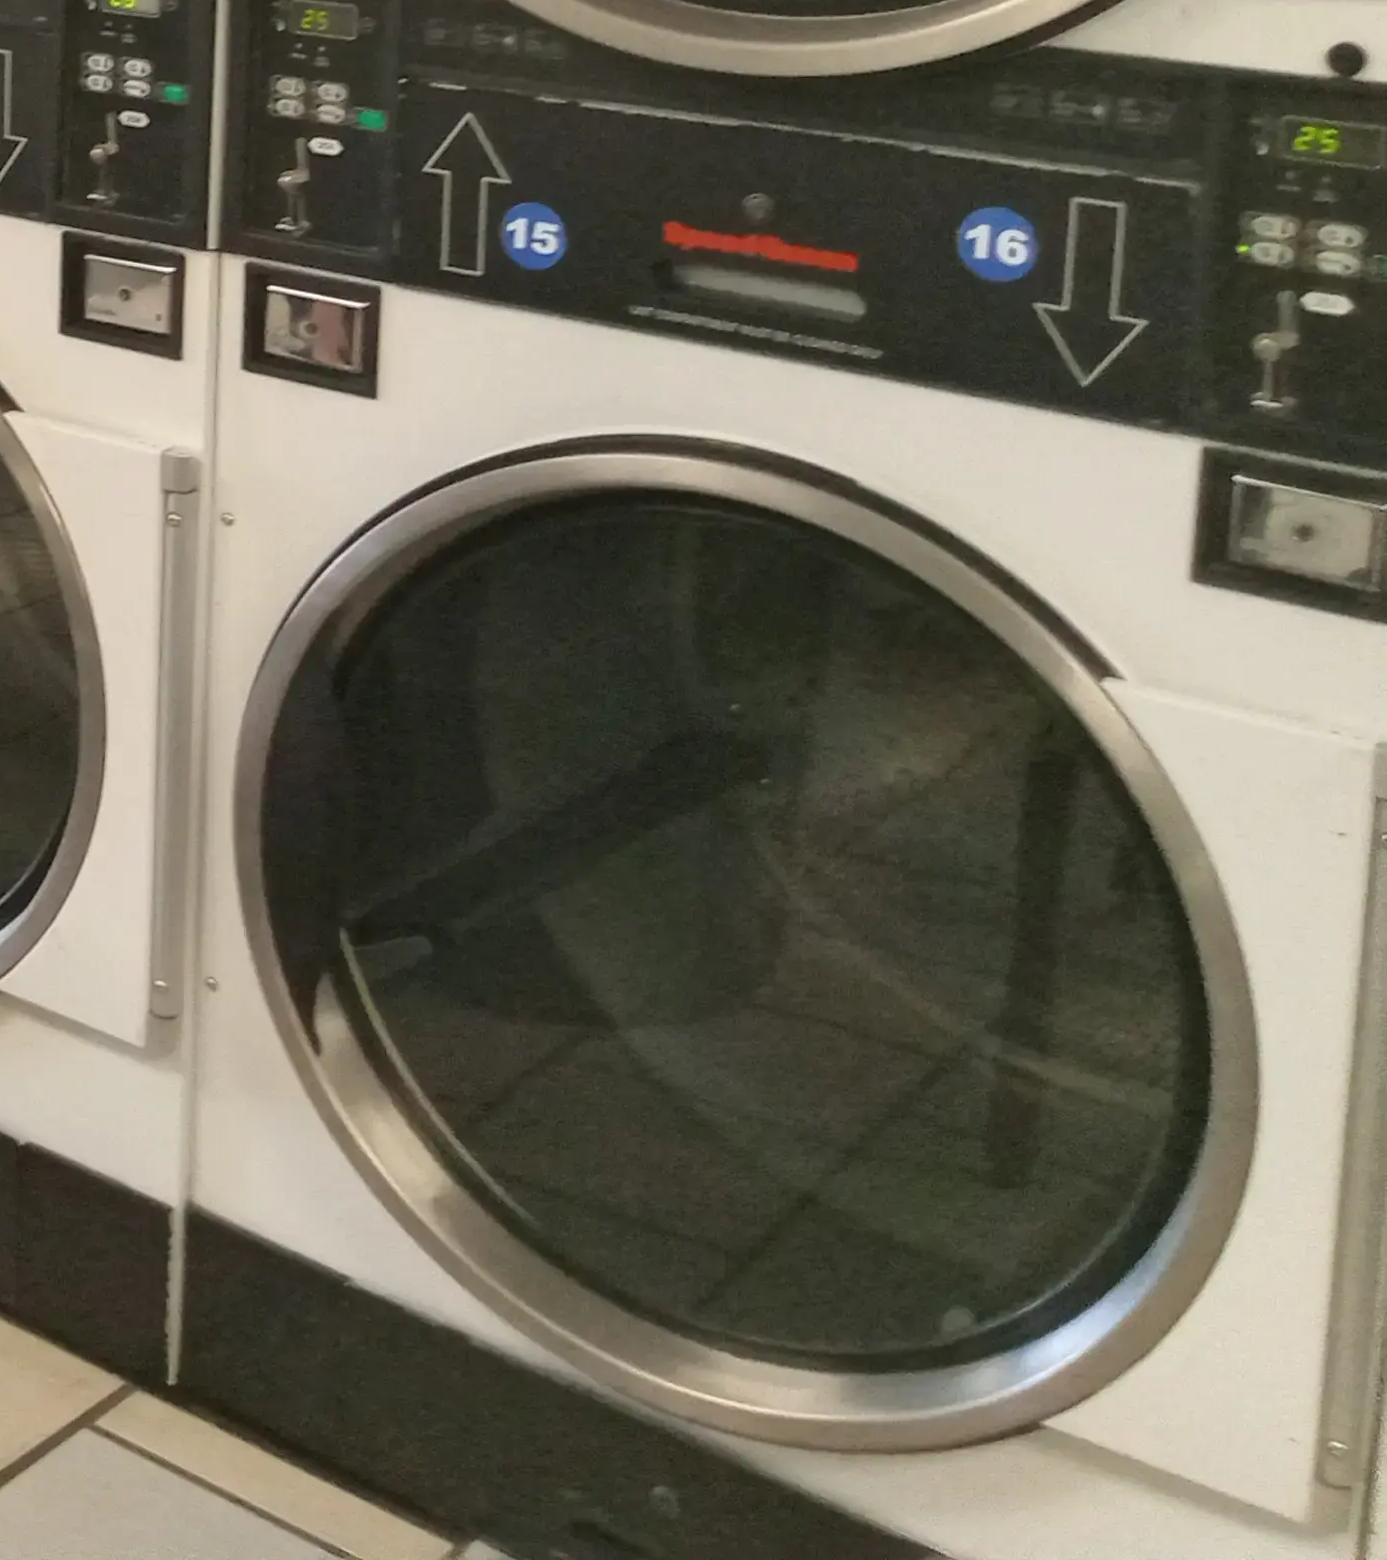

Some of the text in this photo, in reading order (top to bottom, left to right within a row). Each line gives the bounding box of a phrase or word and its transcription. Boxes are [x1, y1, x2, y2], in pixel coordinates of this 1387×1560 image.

[300, 8, 329, 31] 25
[1292, 125, 1342, 154] 25
[506, 218, 561, 255] 15
[964, 223, 1029, 266] 16
